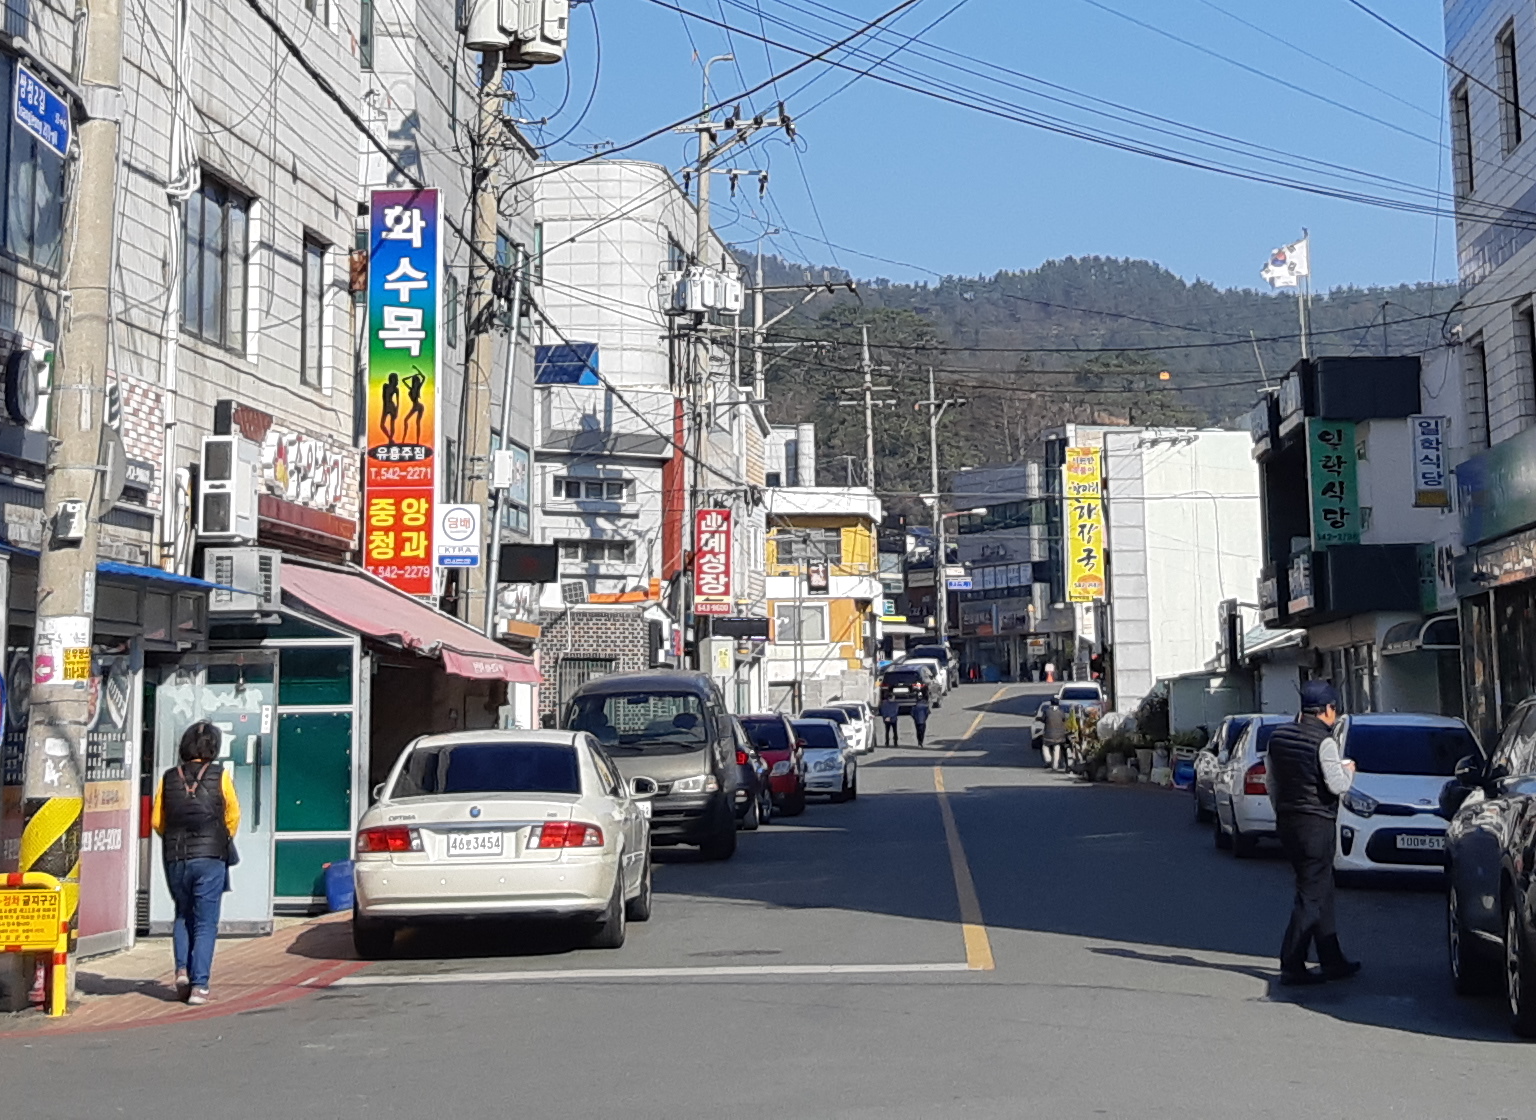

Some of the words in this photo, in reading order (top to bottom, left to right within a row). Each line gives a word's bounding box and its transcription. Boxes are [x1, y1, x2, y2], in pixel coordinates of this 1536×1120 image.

[378, 205, 428, 356] 화수목
[376, 446, 425, 461] 유흥주점
[370, 466, 431, 481] T.542-2271
[369, 497, 428, 527] 중앙
[447, 517, 471, 529] 담배
[369, 530, 428, 559] 청과
